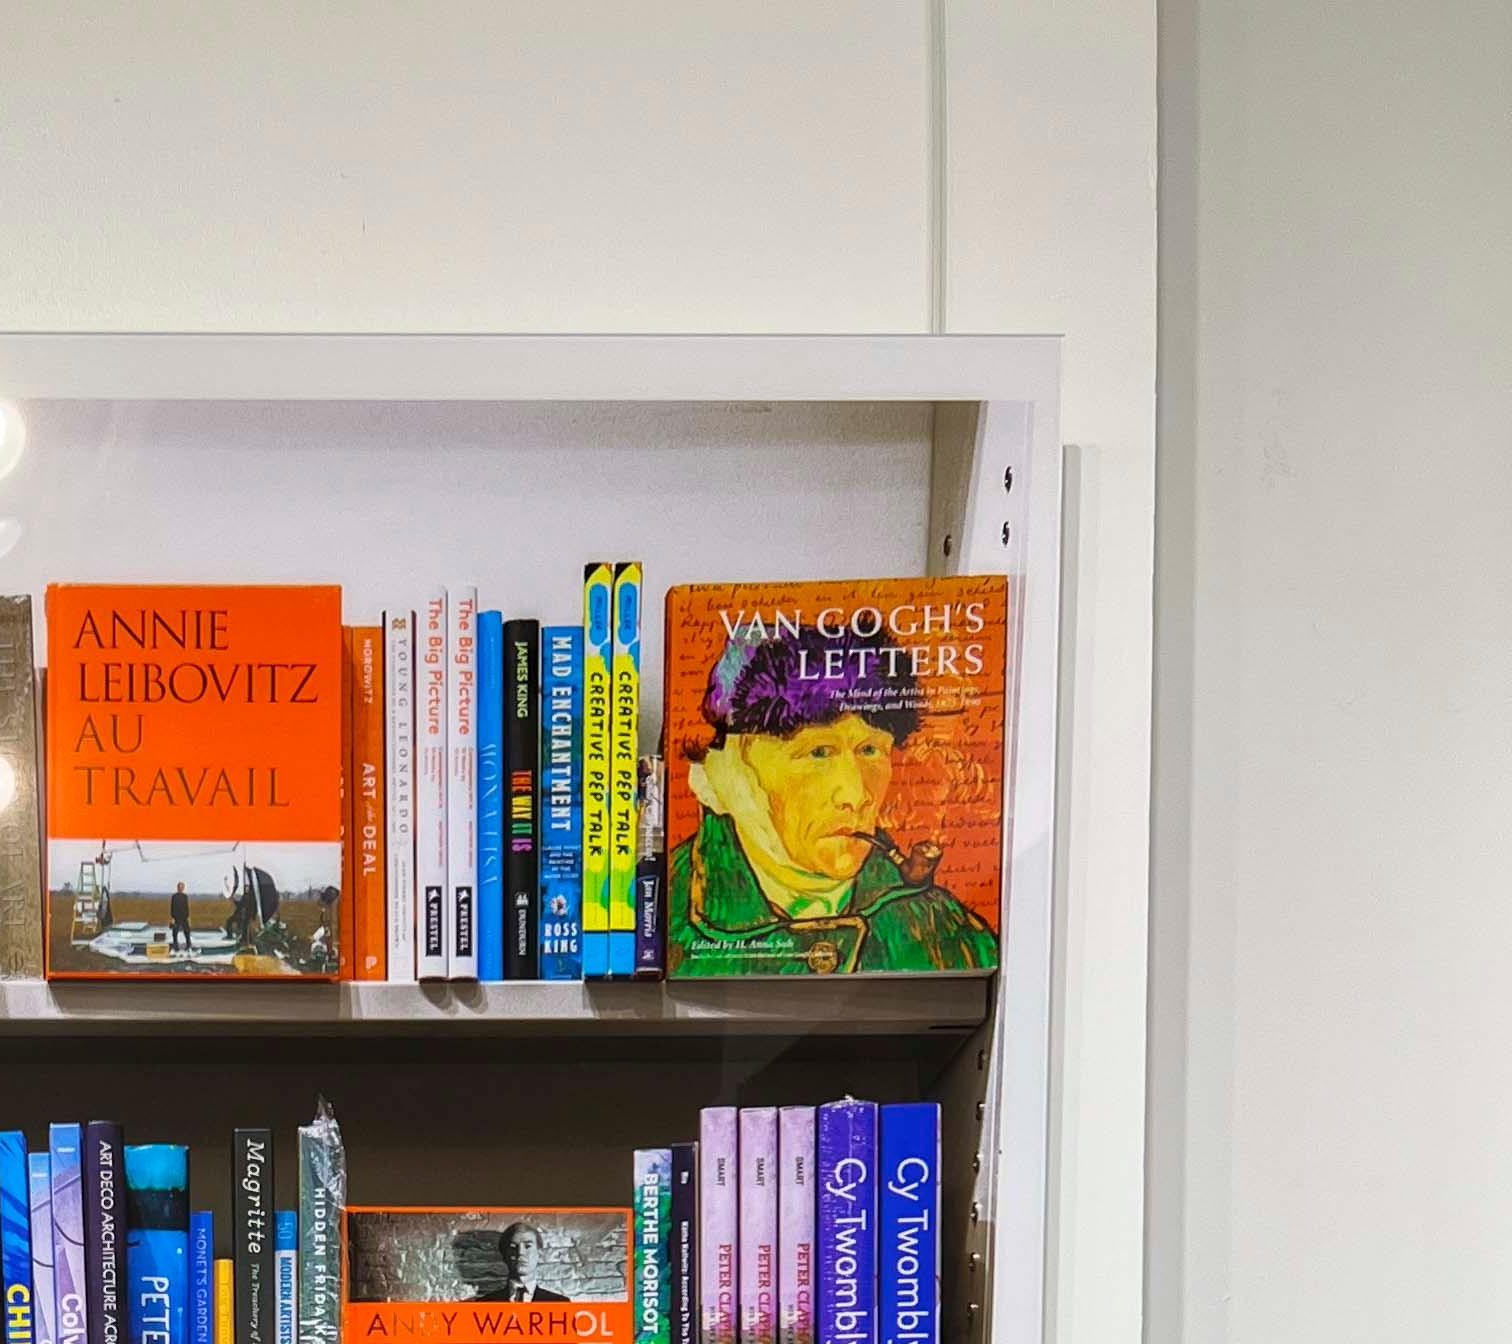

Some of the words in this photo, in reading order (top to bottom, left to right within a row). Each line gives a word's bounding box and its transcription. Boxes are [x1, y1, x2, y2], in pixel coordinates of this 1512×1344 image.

[72, 609, 228, 650] ANNIE
[430, 599, 442, 631] The
[459, 599, 472, 631] The
[718, 607, 801, 641] VAN
[817, 602, 986, 638] GOGH'S
[425, 637, 442, 665] Big
[455, 637, 472, 665] Big
[552, 637, 571, 677] MAD
[798, 644, 985, 680] LETTERS
[79, 663, 318, 704] LEIBOVITZ
[429, 671, 442, 735] Picture
[459, 671, 472, 735] Picture
[74, 713, 143, 754] AU
[590, 672, 604, 761] CREATIVE
[619, 671, 633, 761] CREATIVE
[551, 686, 571, 832] ENCHANTMENT
[74, 766, 290, 807] TRAVAIL
[590, 772, 604, 803] PEP
[617, 771, 632, 802] PEP
[588, 814, 602, 857] TALK
[615, 812, 630, 856] TALK
[242, 1139, 265, 1255] Magritte
[826, 1157, 866, 1202] Cy
[888, 1157, 929, 1201] Cy
[641, 1173, 658, 1246] BERTHE
[640, 1249, 658, 1334] MORISOT
[474, 1311, 613, 1336] WARHOL
